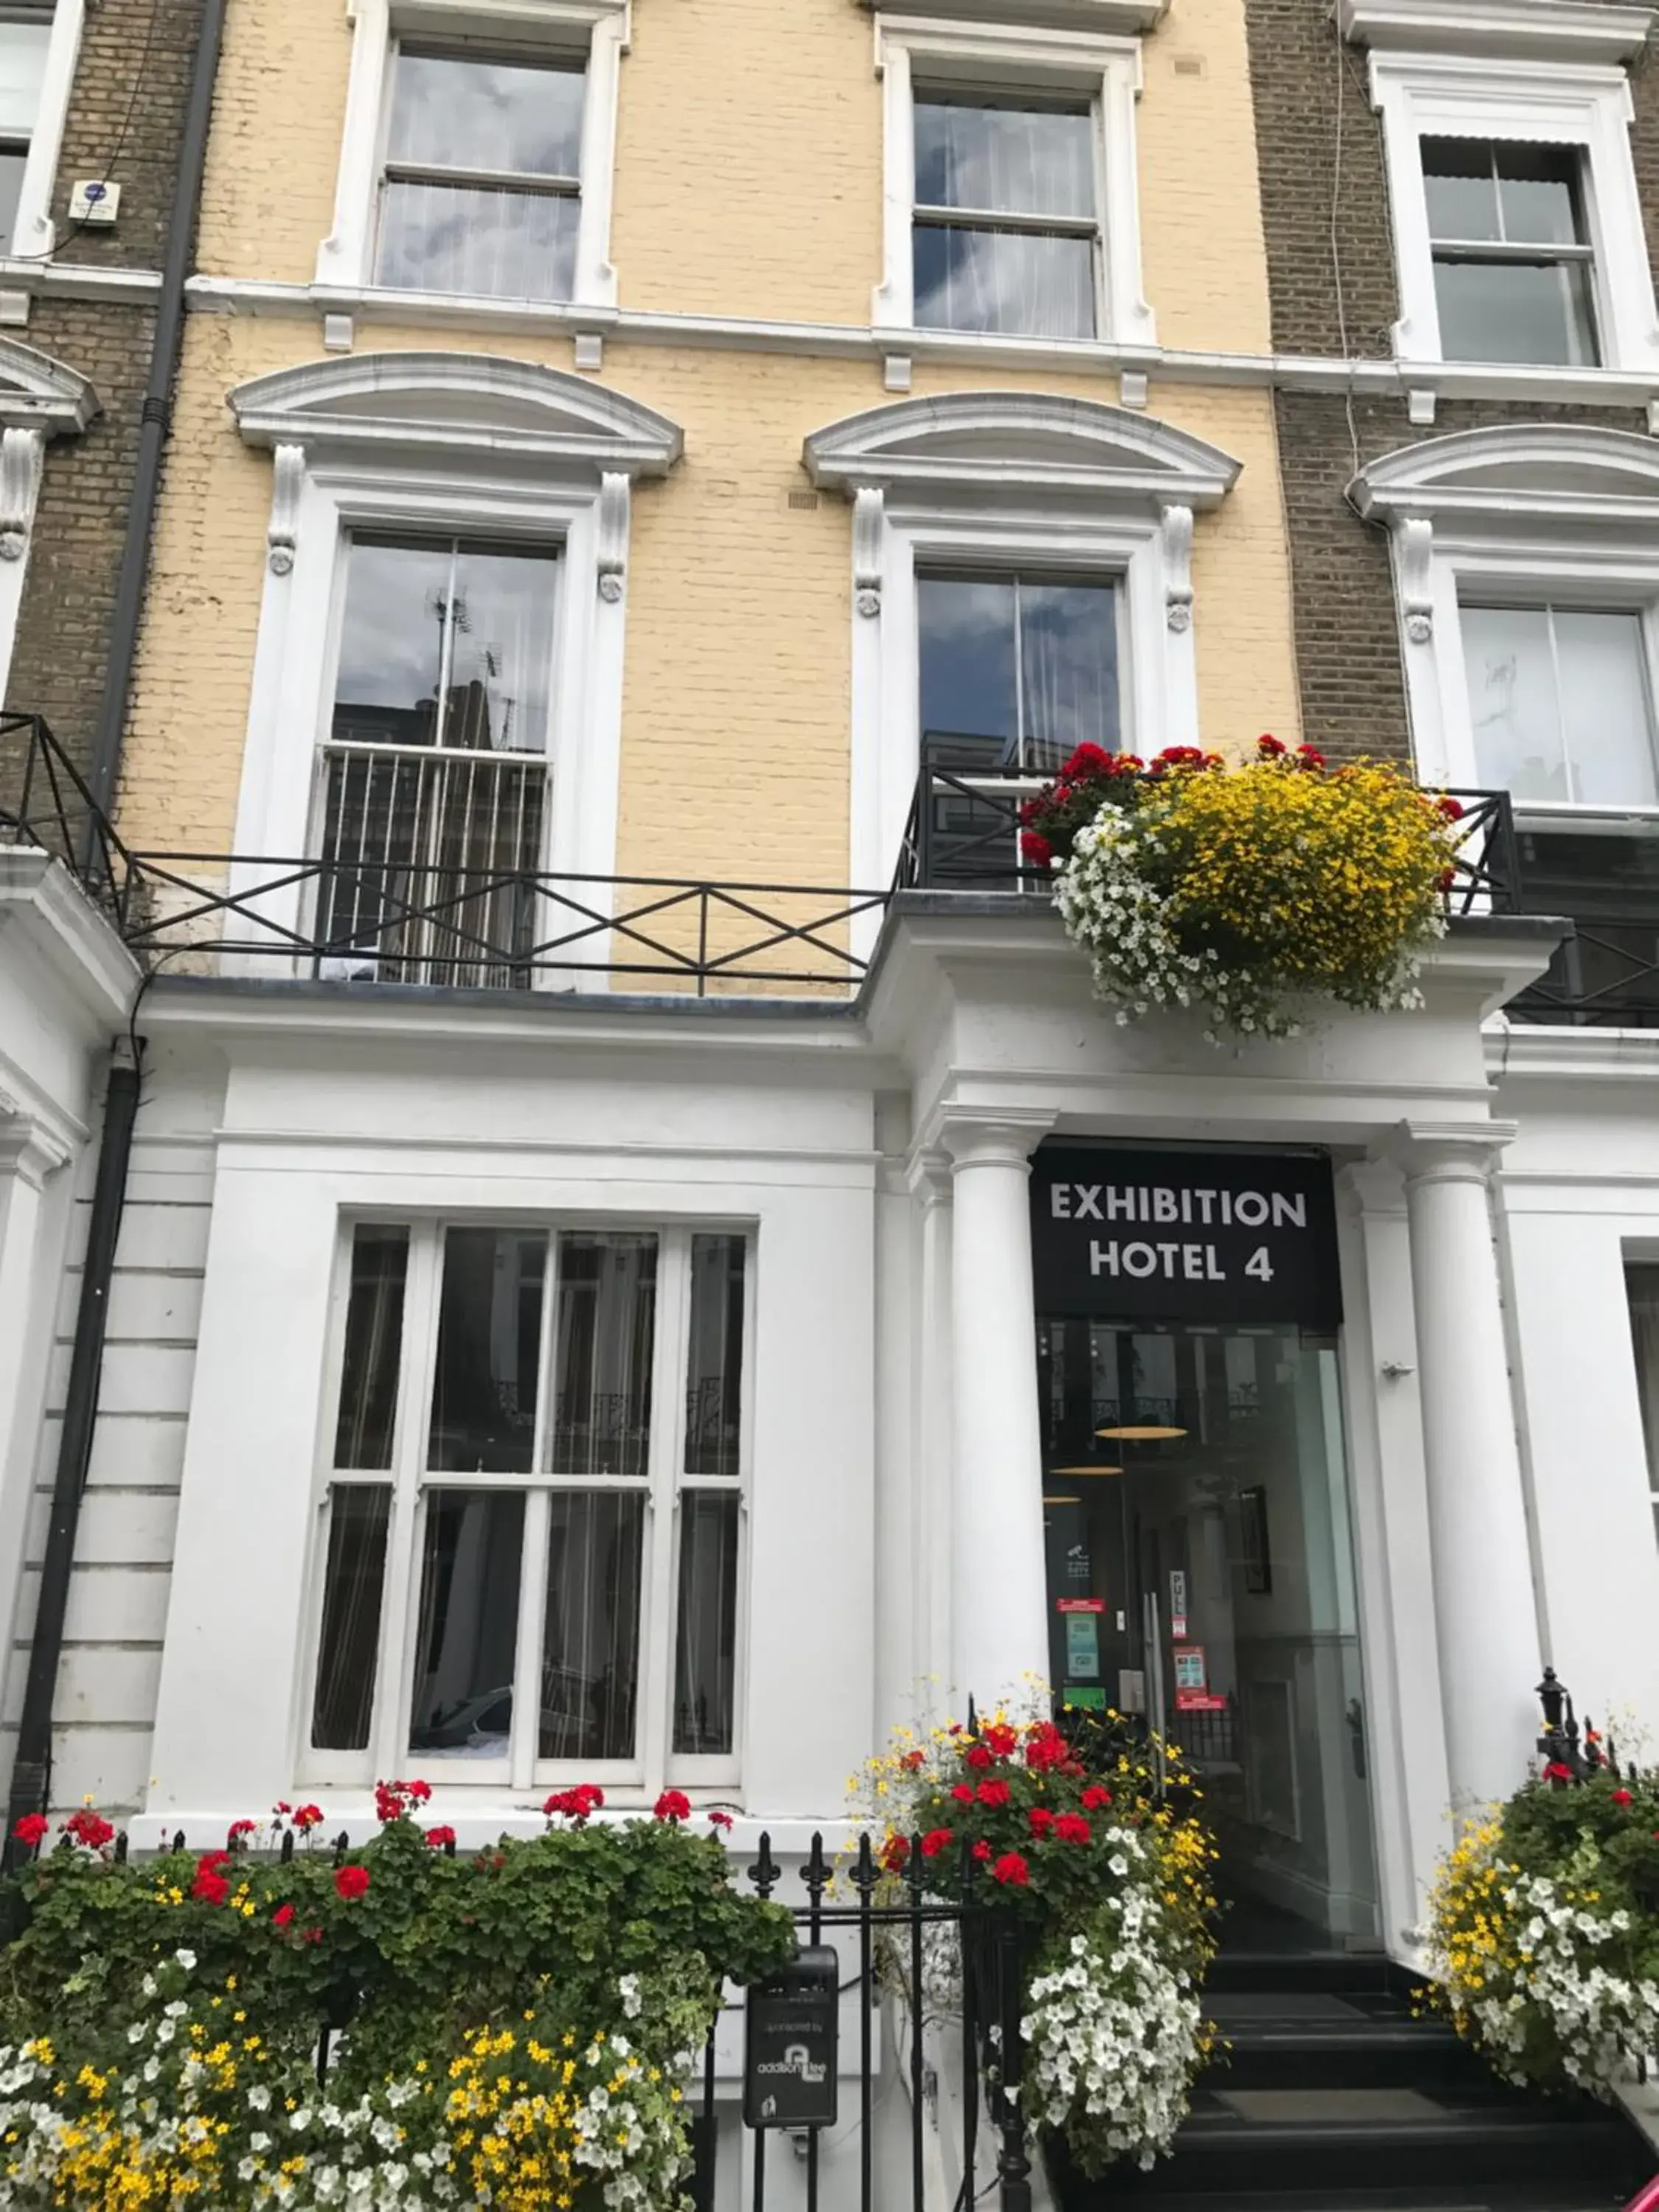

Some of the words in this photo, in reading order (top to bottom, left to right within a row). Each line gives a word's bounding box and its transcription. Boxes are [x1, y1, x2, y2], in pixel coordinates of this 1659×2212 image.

[1051, 1183, 1307, 1227] EXHIBITION
[1089, 1239, 1226, 1281] HOTEL
[1244, 1246, 1274, 1283] 4
[1174, 1574, 1182, 1615] PULL
